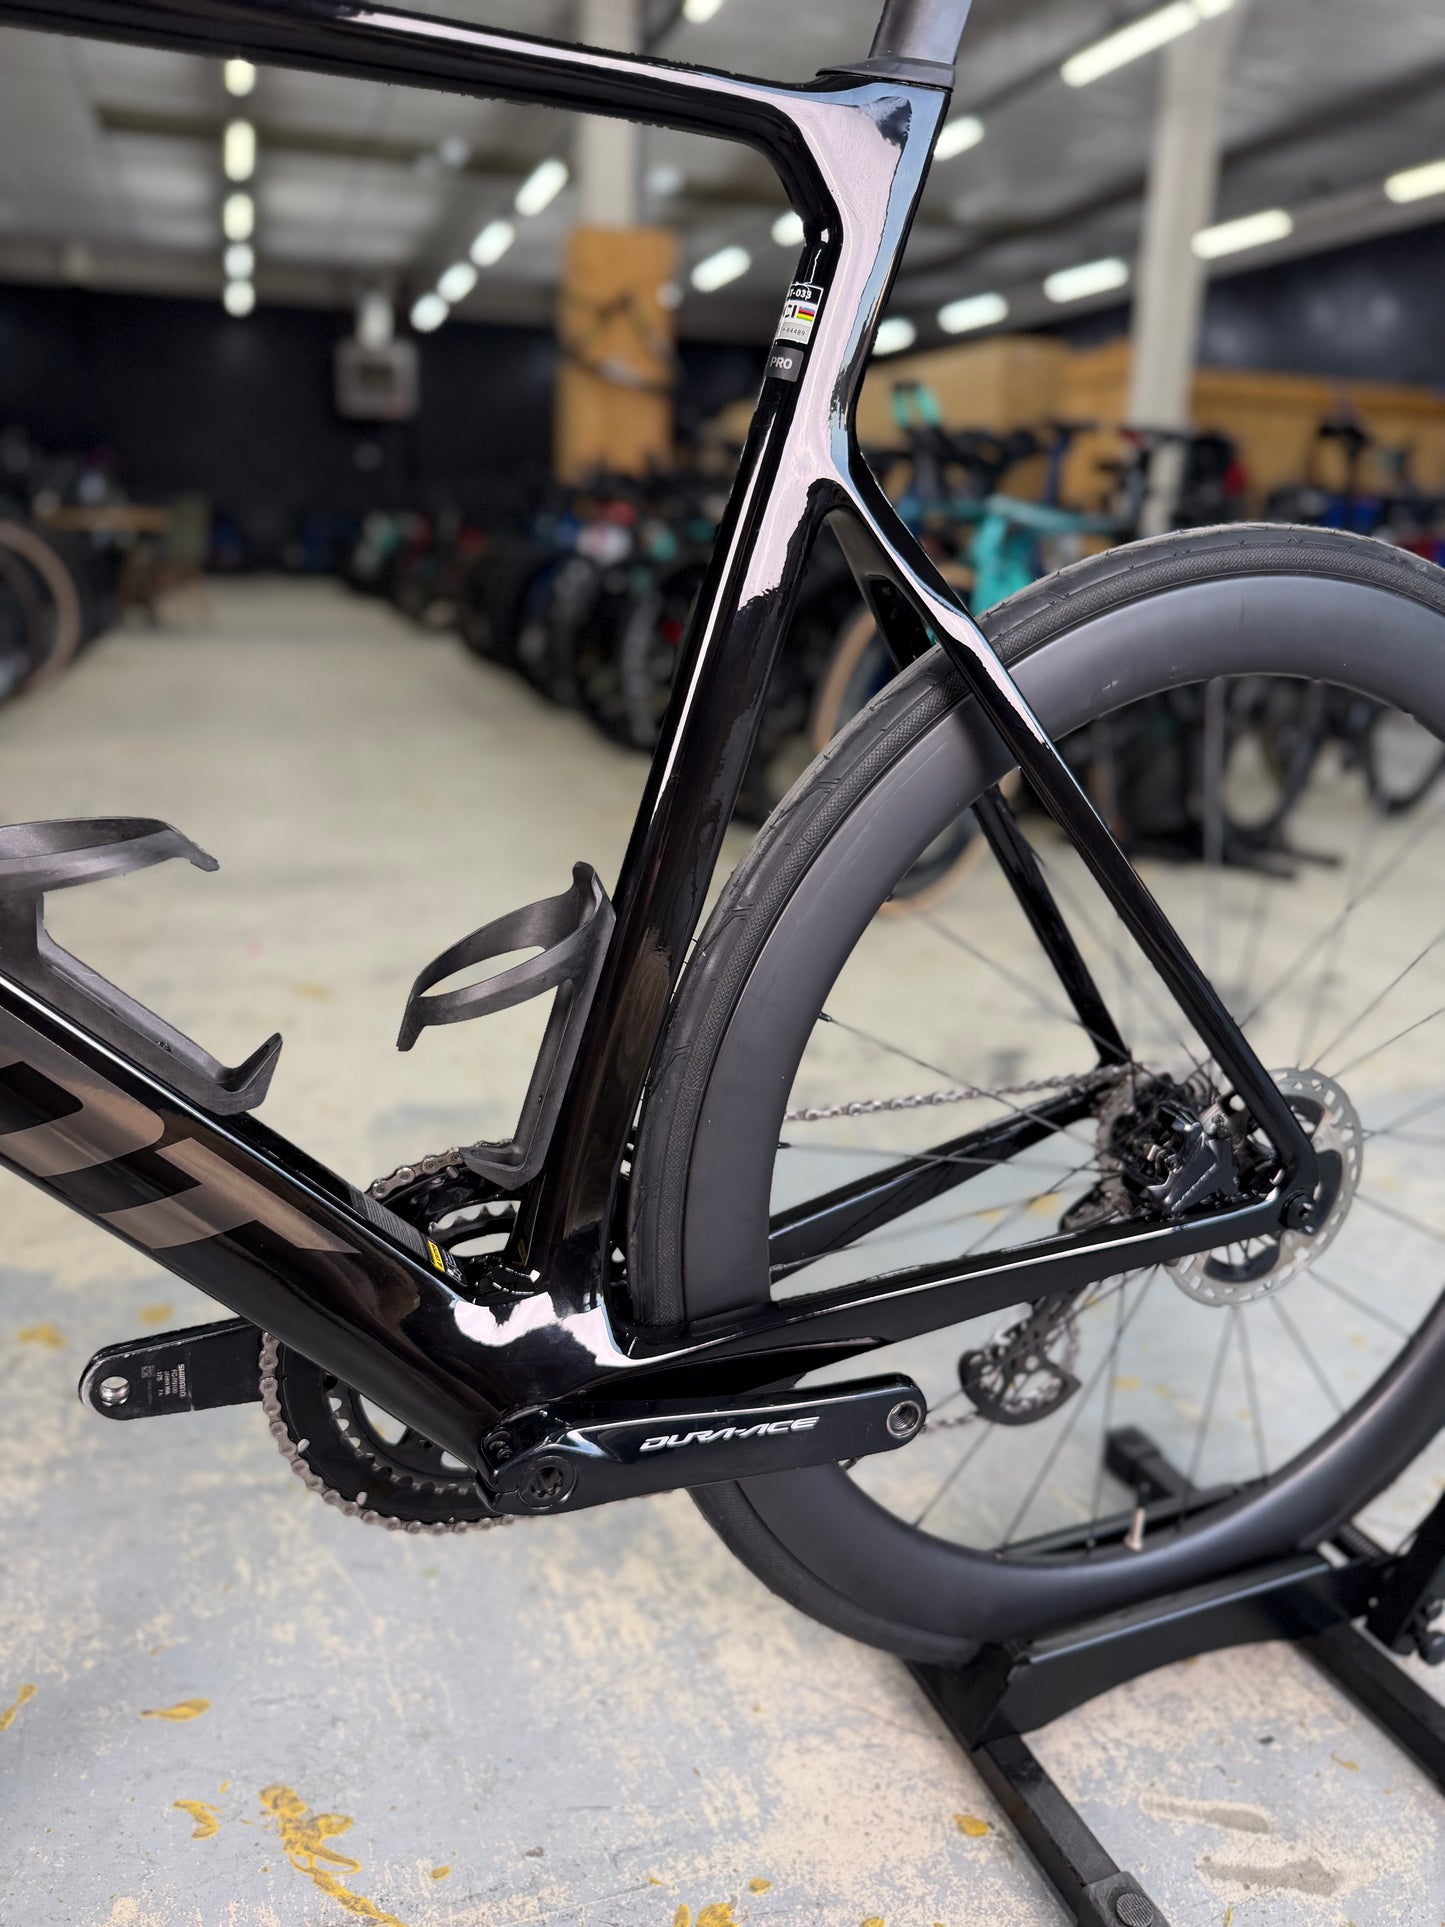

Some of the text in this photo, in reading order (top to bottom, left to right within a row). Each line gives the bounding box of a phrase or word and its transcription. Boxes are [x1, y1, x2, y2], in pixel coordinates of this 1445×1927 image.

[769, 356, 793, 370] PRO
[178, 1363, 187, 1398] SHIMANO
[639, 1416, 820, 1452] DURA-ACE
